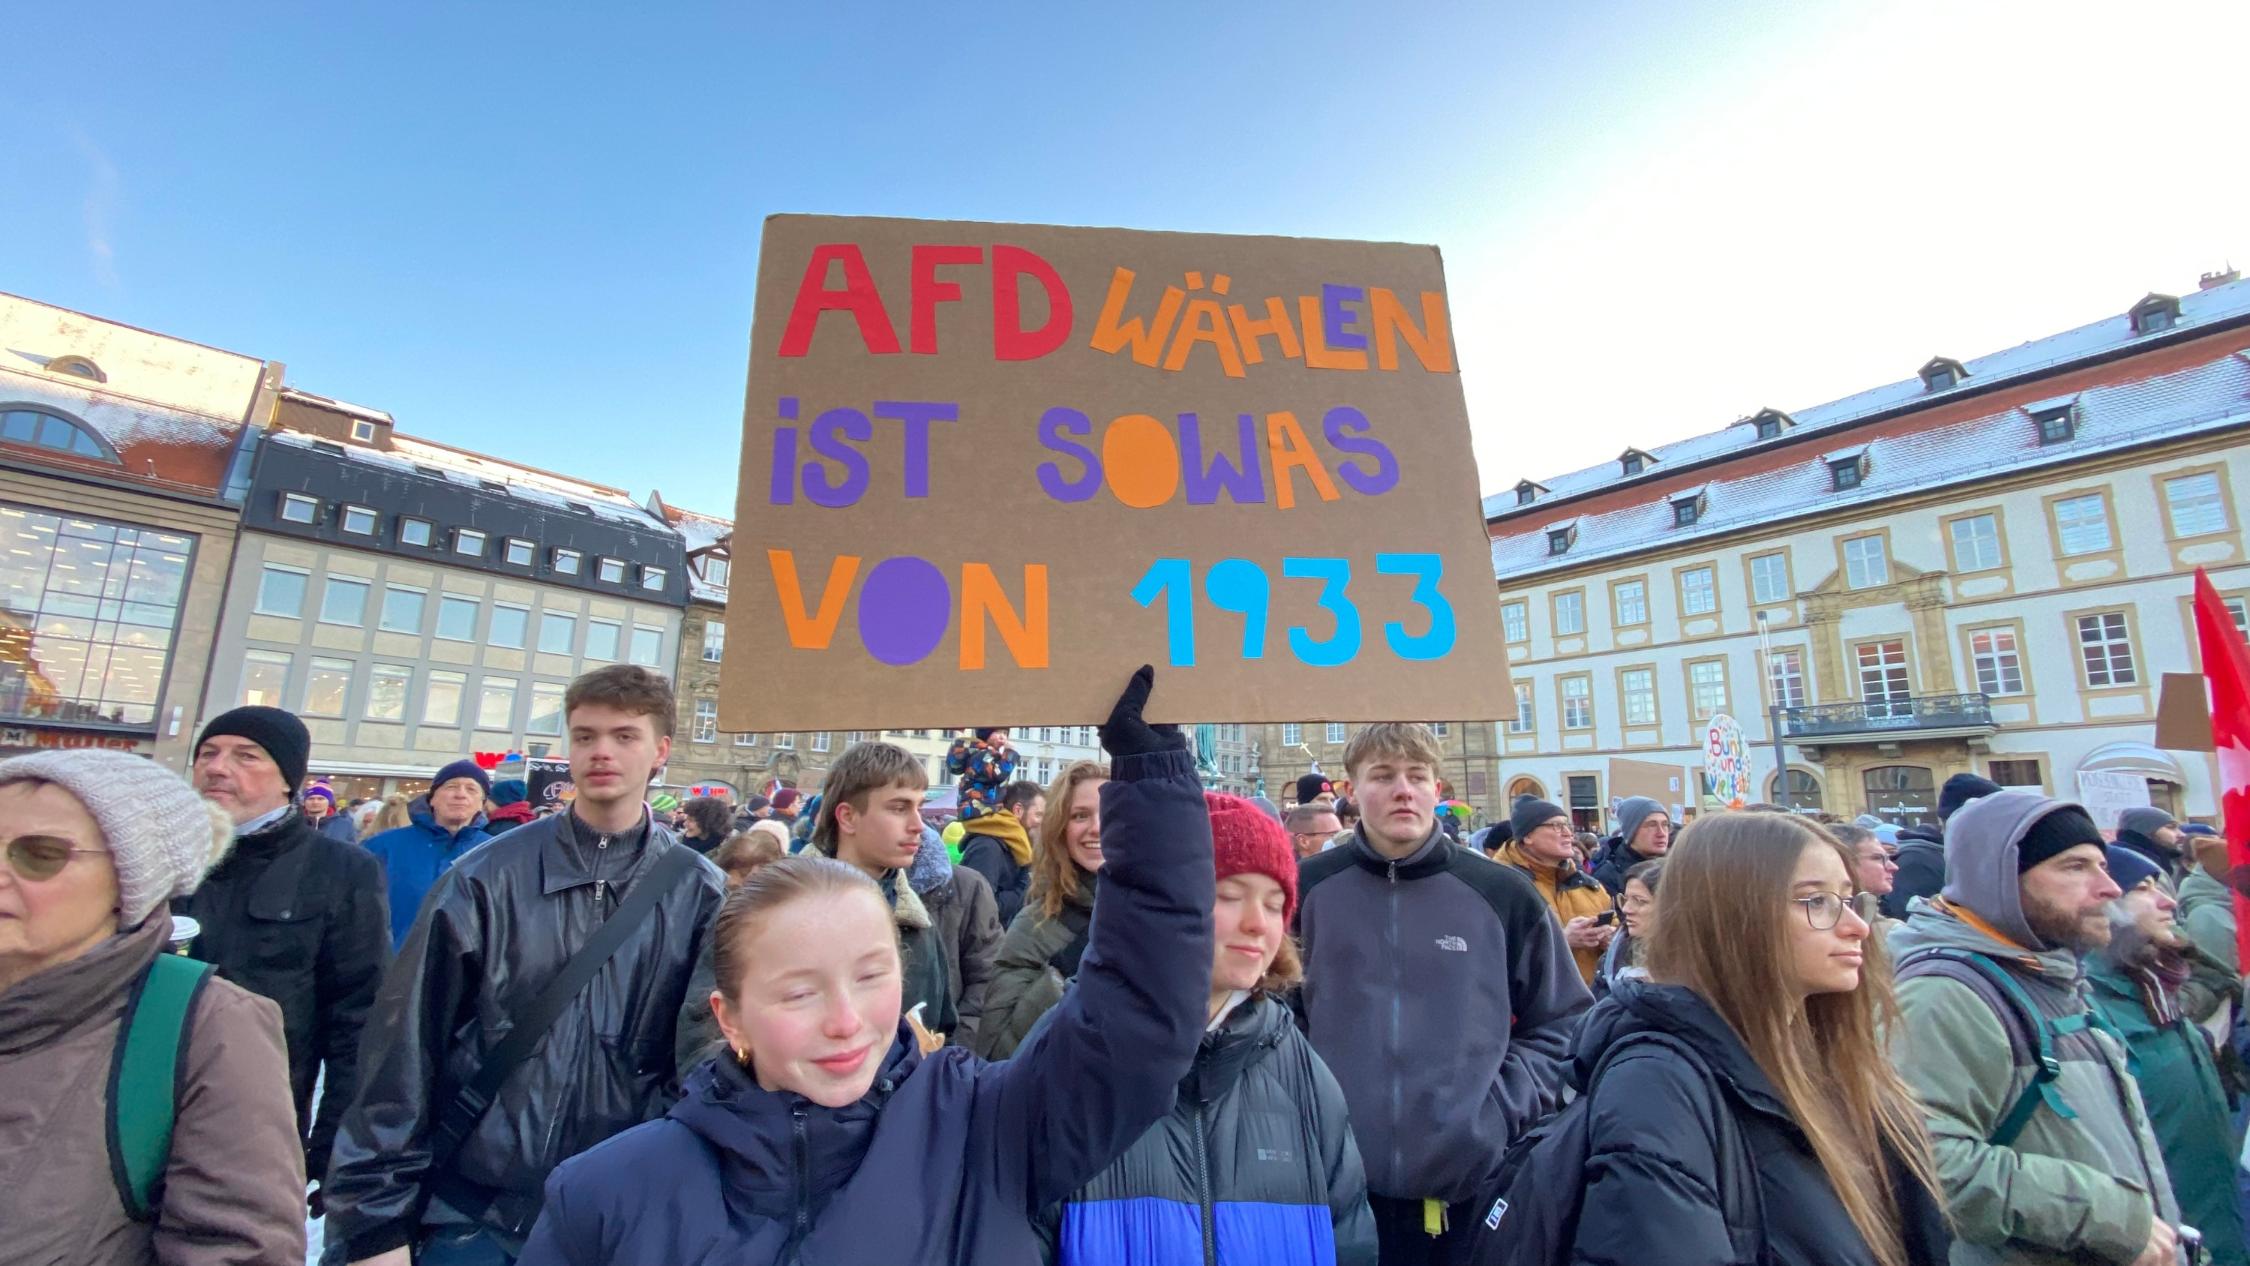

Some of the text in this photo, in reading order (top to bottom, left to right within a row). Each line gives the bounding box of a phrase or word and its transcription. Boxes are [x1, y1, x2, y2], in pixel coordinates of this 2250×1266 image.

[779, 244, 1452, 378] AFD WÄHLEN
[1036, 406, 1399, 510] SOWAS
[767, 548, 1457, 672] VON 1933
[1709, 728, 1743, 757] Bunt
